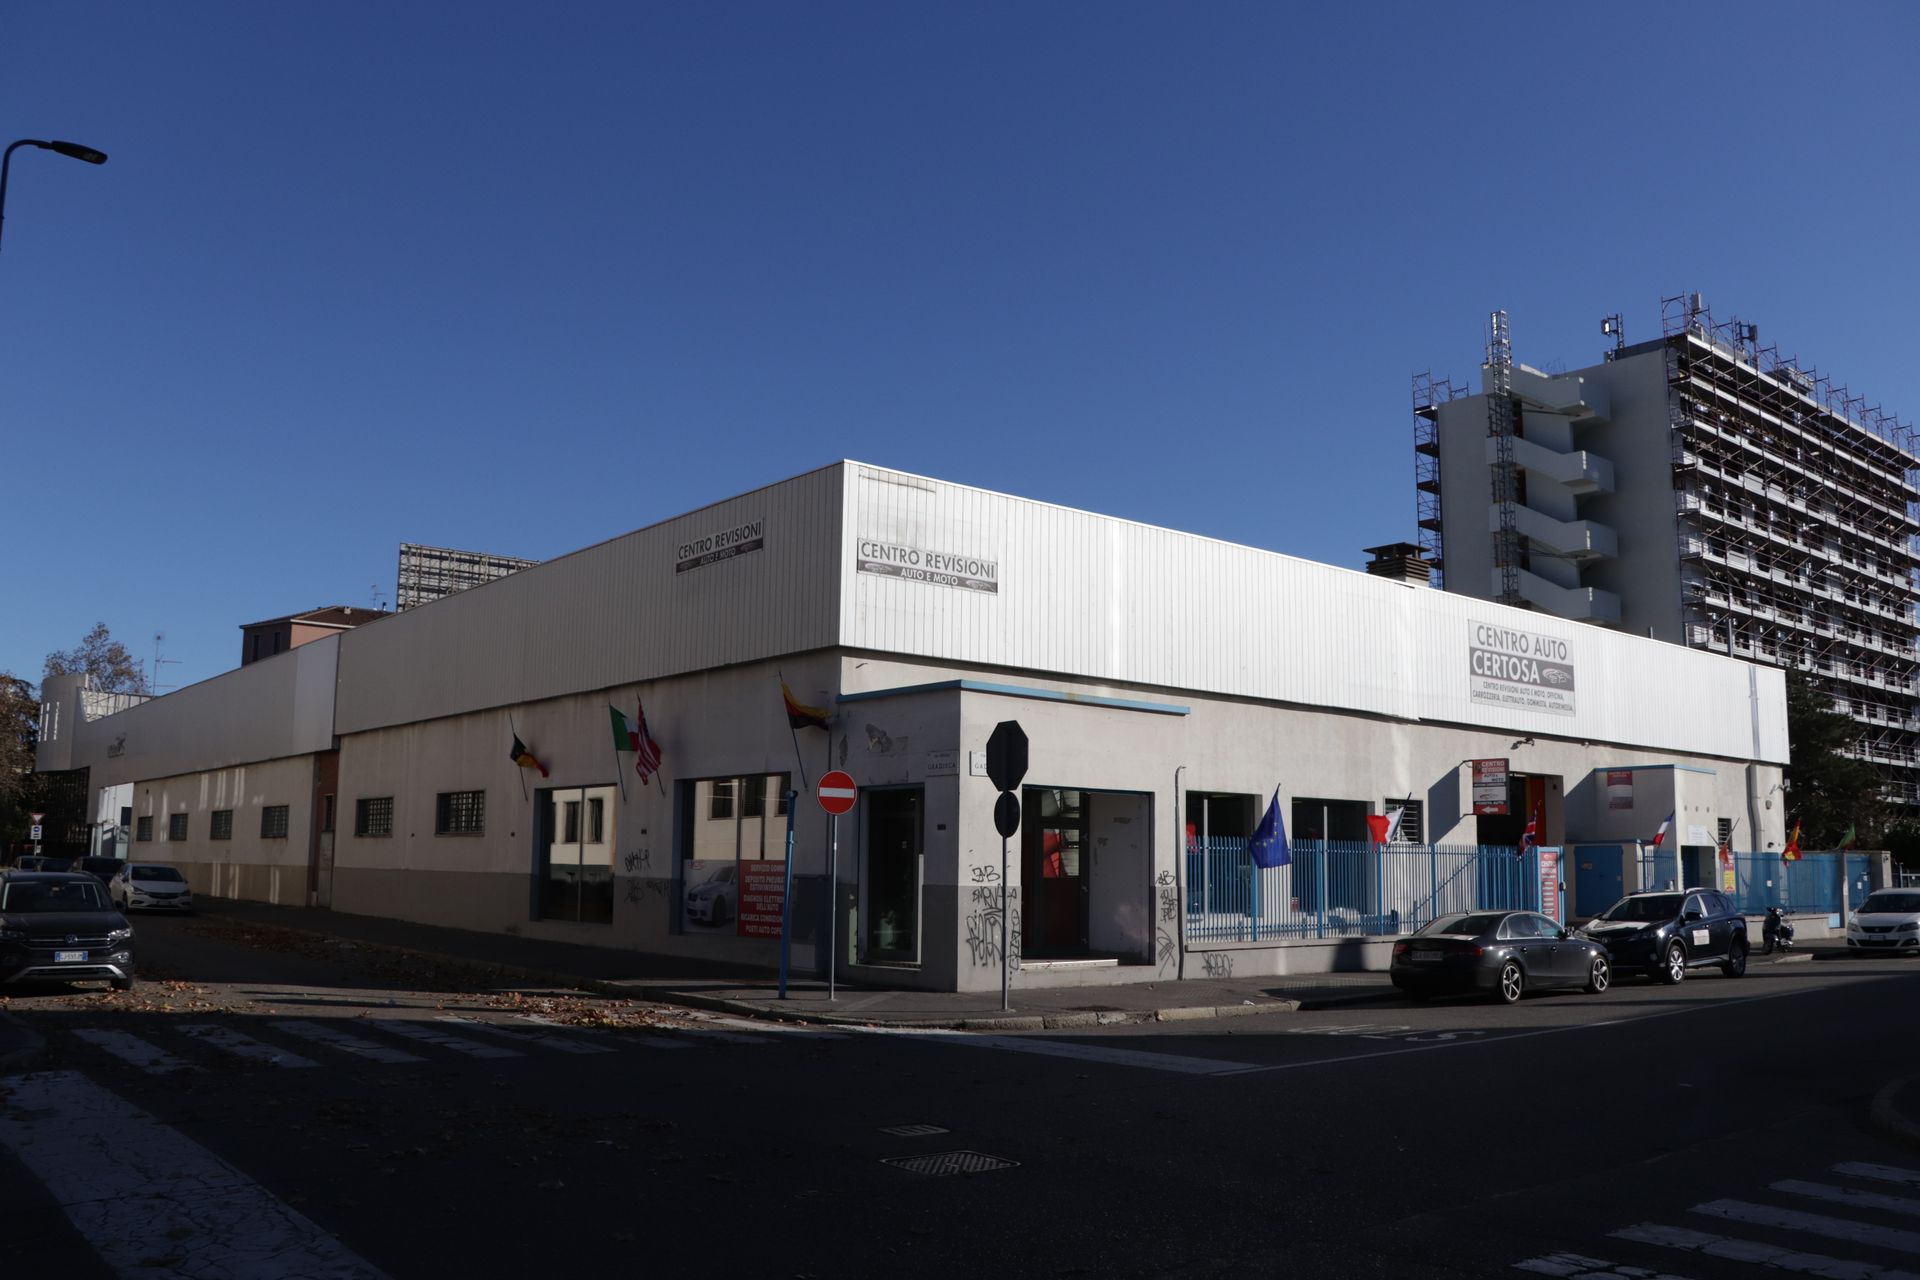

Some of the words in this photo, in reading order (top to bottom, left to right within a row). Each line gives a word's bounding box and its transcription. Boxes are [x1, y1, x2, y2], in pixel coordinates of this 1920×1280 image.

[678, 537, 712, 560] CENTRO
[715, 521, 762, 549] REVISIONI
[700, 553, 714, 565] AUTO
[719, 547, 736, 560] MOTO
[861, 542, 919, 565] CENTRO
[925, 552, 994, 578] REVISIONI
[900, 568, 924, 580] AUTO
[926, 572, 930, 580] E
[933, 573, 958, 585] MOTO
[1477, 625, 1529, 654] CENTRO
[1534, 637, 1567, 661] AUTO
[1472, 650, 1541, 684] CERTOSA
[1483, 681, 1500, 690] CENTRO
[1520, 686, 1531, 695] AUTO
